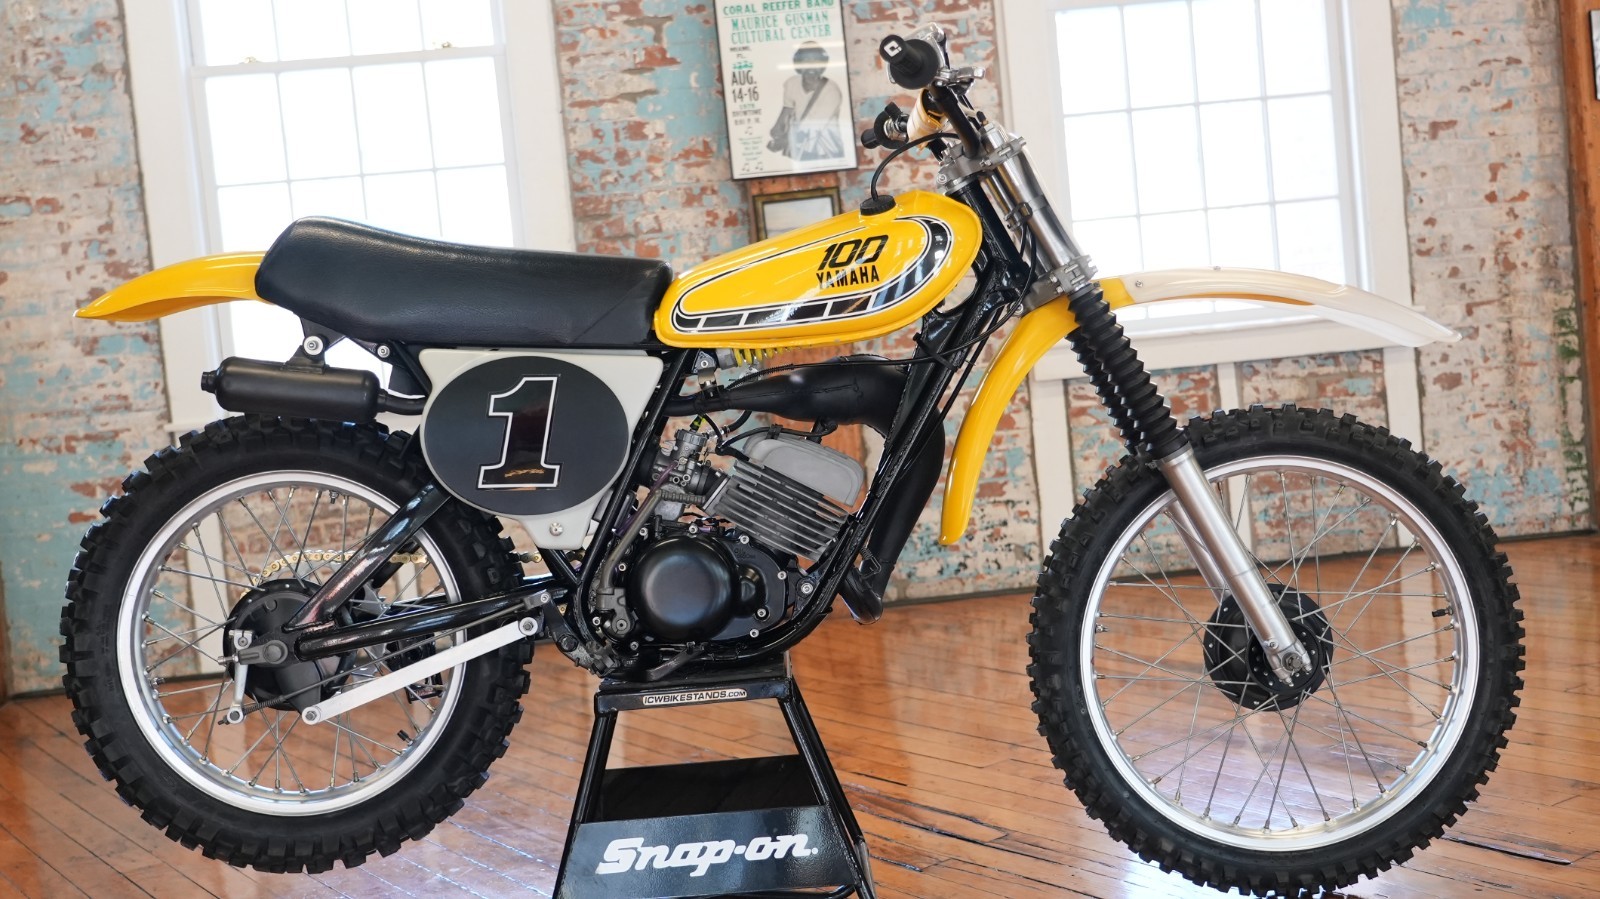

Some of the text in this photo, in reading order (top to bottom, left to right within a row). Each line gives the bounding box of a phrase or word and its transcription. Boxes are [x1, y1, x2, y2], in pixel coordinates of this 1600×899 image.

[723, 4, 757, 15] CORAL
[762, 0, 800, 12] REEFER
[731, 11, 829, 31] MAURICE GUSMAN
[731, 24, 832, 45] CULTURAL CENTER
[731, 70, 757, 86] AUG.
[732, 86, 760, 103] 14-16
[818, 234, 889, 271] 100
[816, 264, 880, 290] YAMAHA
[478, 376, 561, 489] 1
[644, 690, 746, 704] ICWBIKESTANDS.COM
